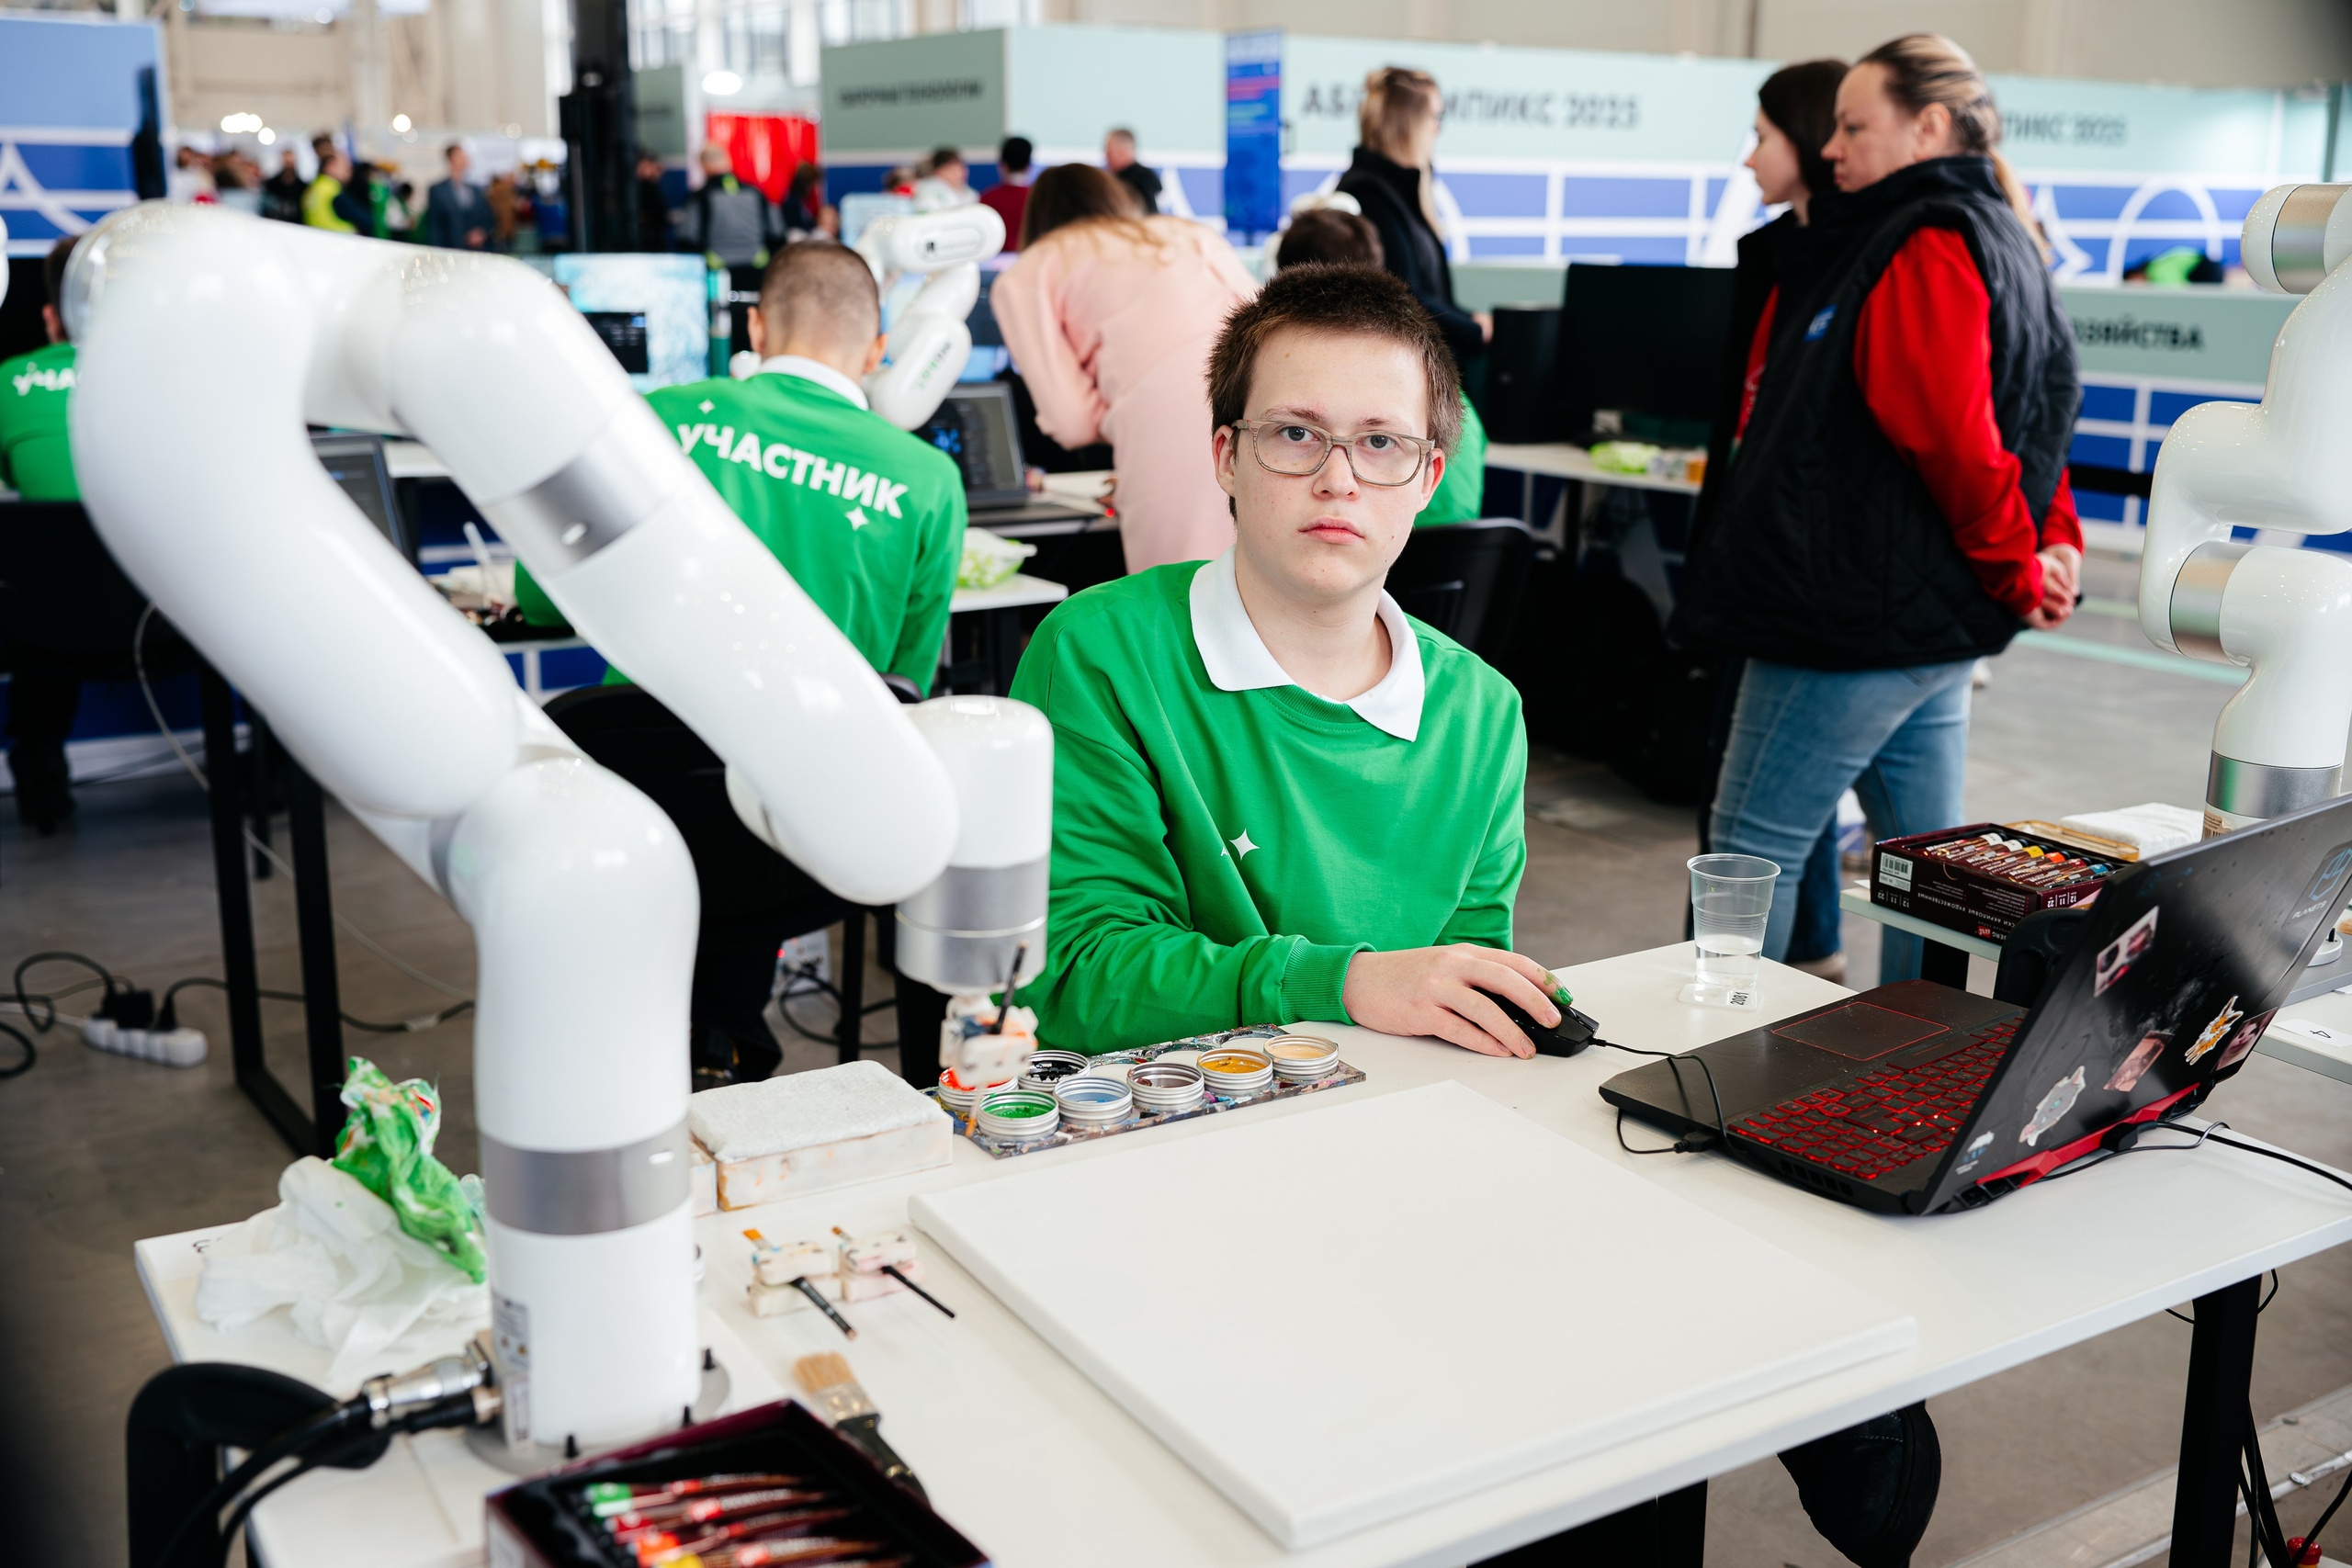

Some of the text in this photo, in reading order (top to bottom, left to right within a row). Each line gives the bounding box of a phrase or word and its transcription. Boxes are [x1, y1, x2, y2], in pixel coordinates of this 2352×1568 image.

[2074, 314, 2205, 352] ЗЯЙСТВА
[12, 367, 75, 397] УЧА
[676, 423, 910, 520] УЧАСТНИК
[2309, 1030, 2333, 1039] 4
